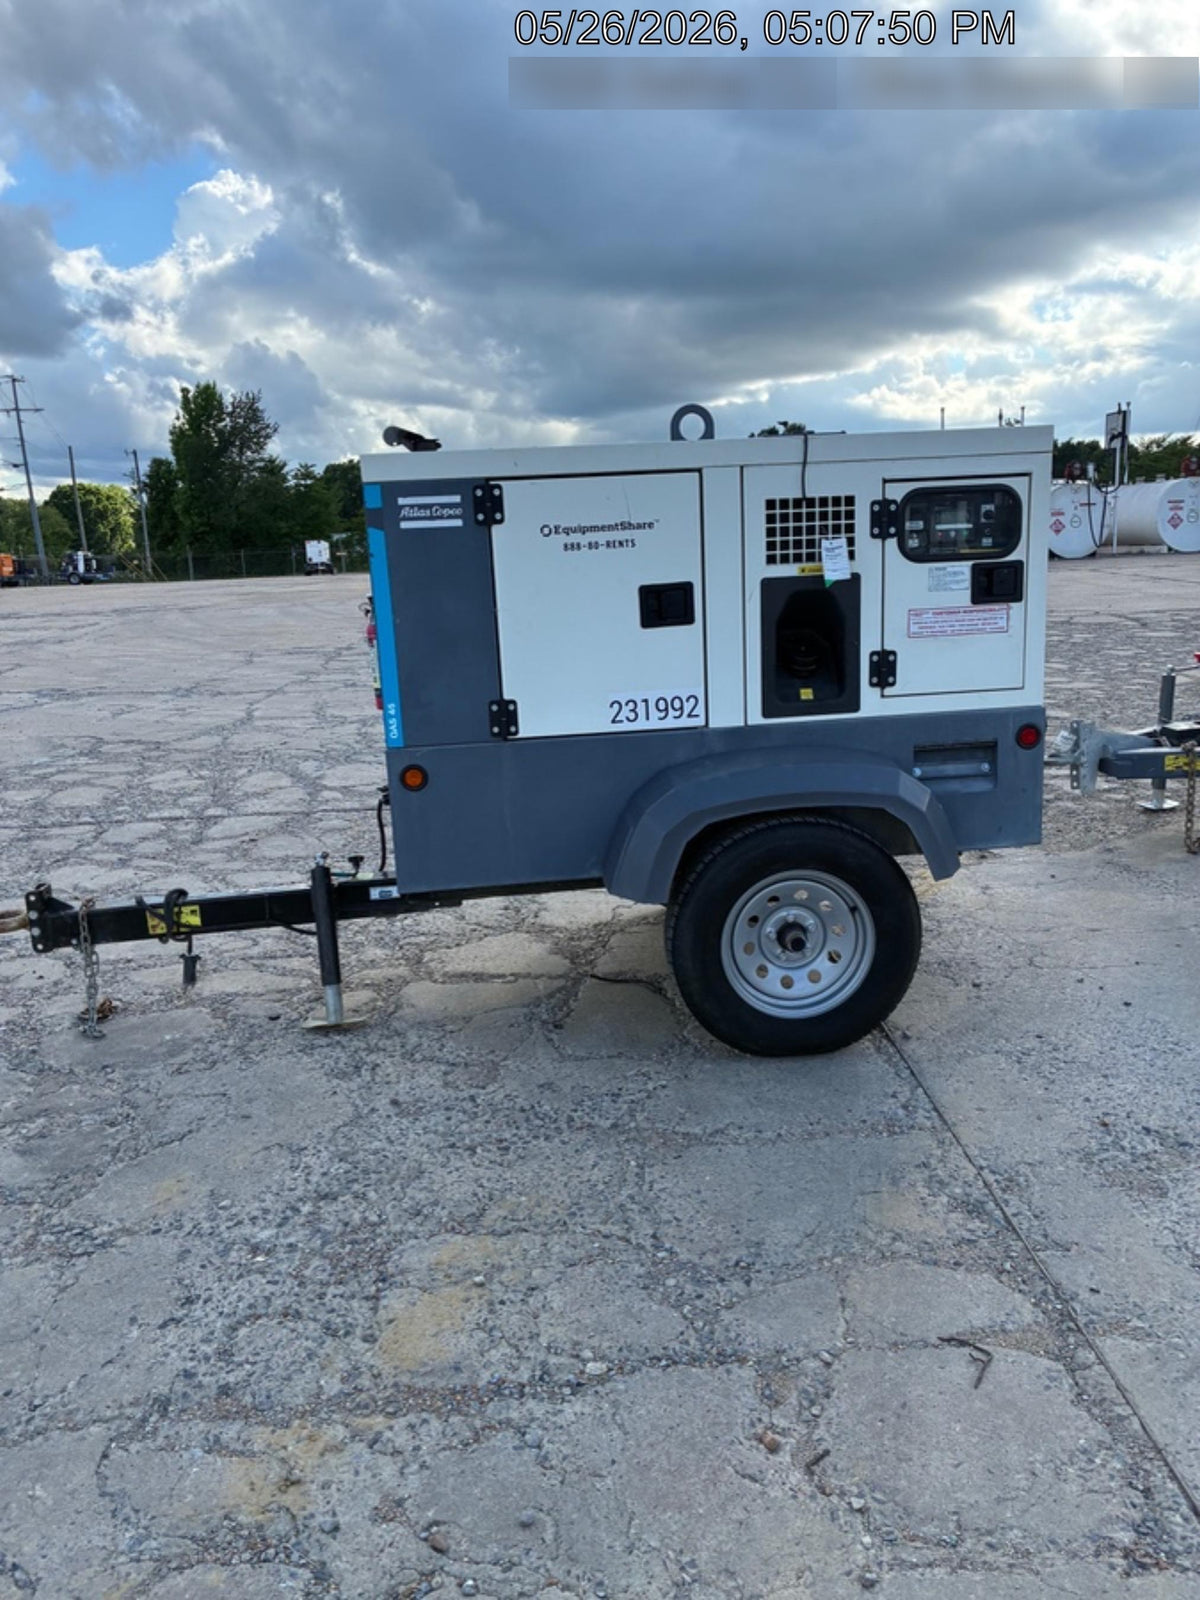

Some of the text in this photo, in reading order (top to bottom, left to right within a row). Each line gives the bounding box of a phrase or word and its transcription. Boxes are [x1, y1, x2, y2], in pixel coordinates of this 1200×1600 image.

[399, 505, 463, 518] Atlas Copco
[609, 694, 700, 724] 231992
